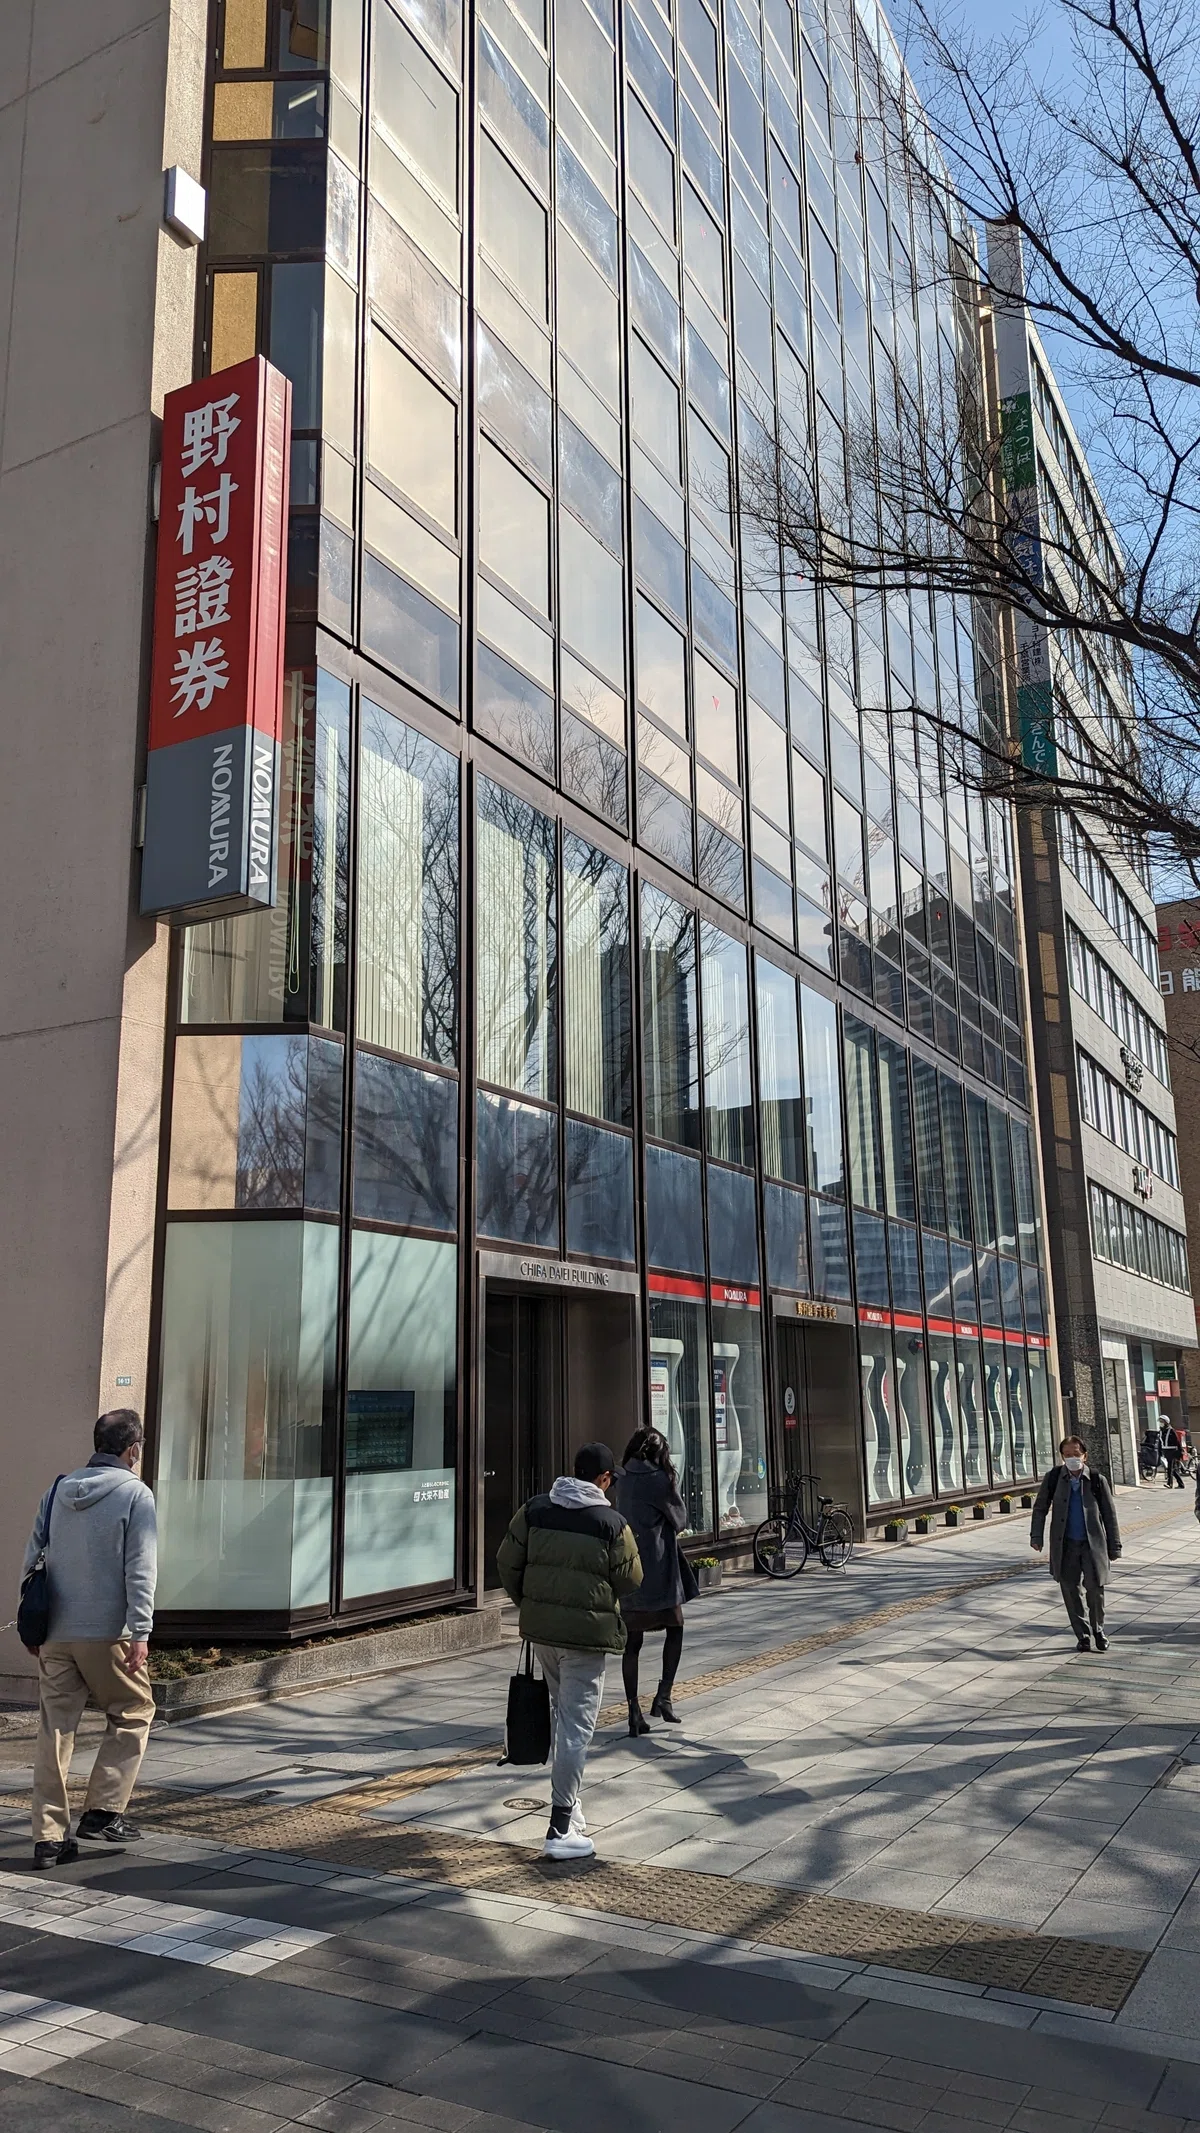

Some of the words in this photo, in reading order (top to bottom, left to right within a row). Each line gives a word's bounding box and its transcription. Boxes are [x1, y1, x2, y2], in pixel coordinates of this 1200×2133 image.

[169, 392, 241, 719] 野村證券
[207, 743, 233, 889] NOMURA
[250, 744, 273, 884] NOMURA
[520, 1261, 547, 1278] CHIBA
[549, 1265, 570, 1281] DAIEI
[572, 1267, 609, 1286] BUILDING
[724, 1289, 747, 1302] NOMURA
[866, 1311, 883, 1322] NOMURA
[420, 1489, 449, 1501] 大栄不動産
